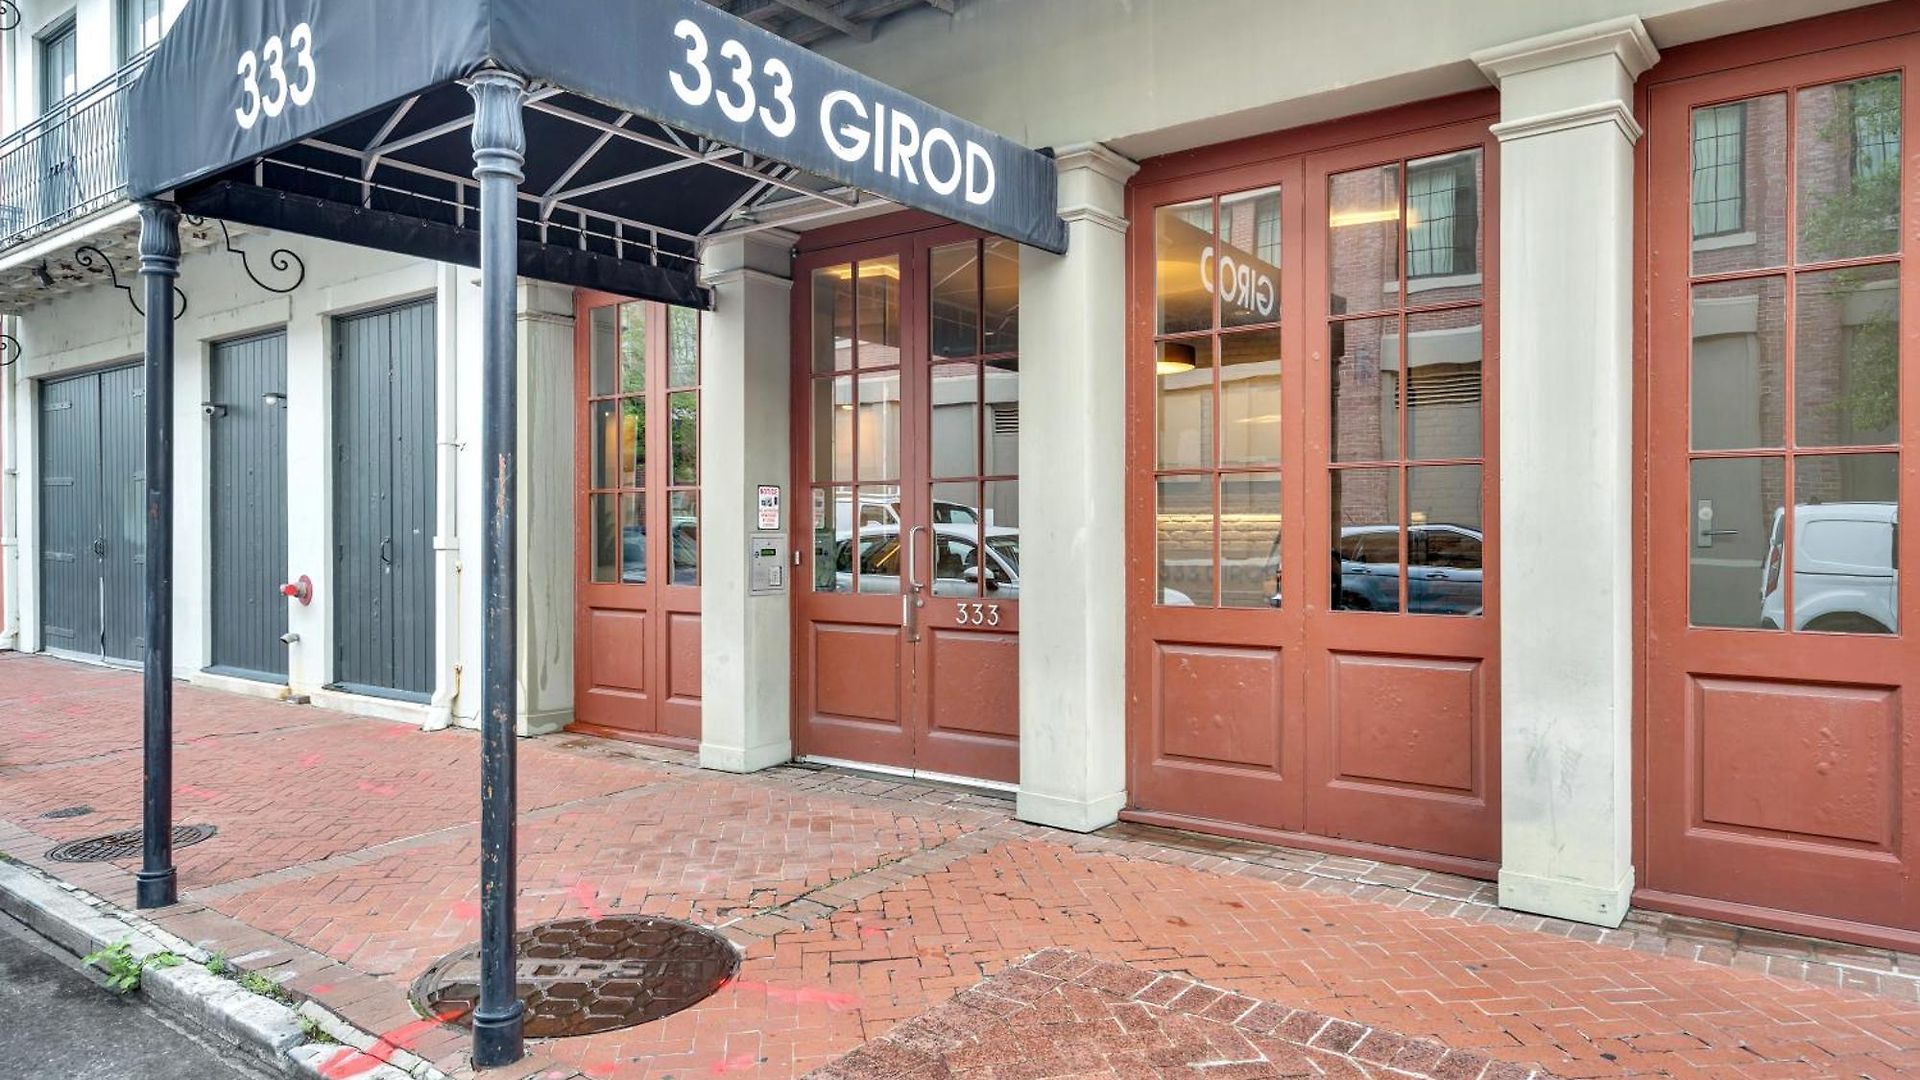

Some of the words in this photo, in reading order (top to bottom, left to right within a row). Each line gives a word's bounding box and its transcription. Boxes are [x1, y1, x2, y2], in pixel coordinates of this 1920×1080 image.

[235, 22, 316, 129] 333
[669, 19, 796, 138] 333
[820, 90, 996, 205] GIROD
[956, 603, 999, 626] 333
